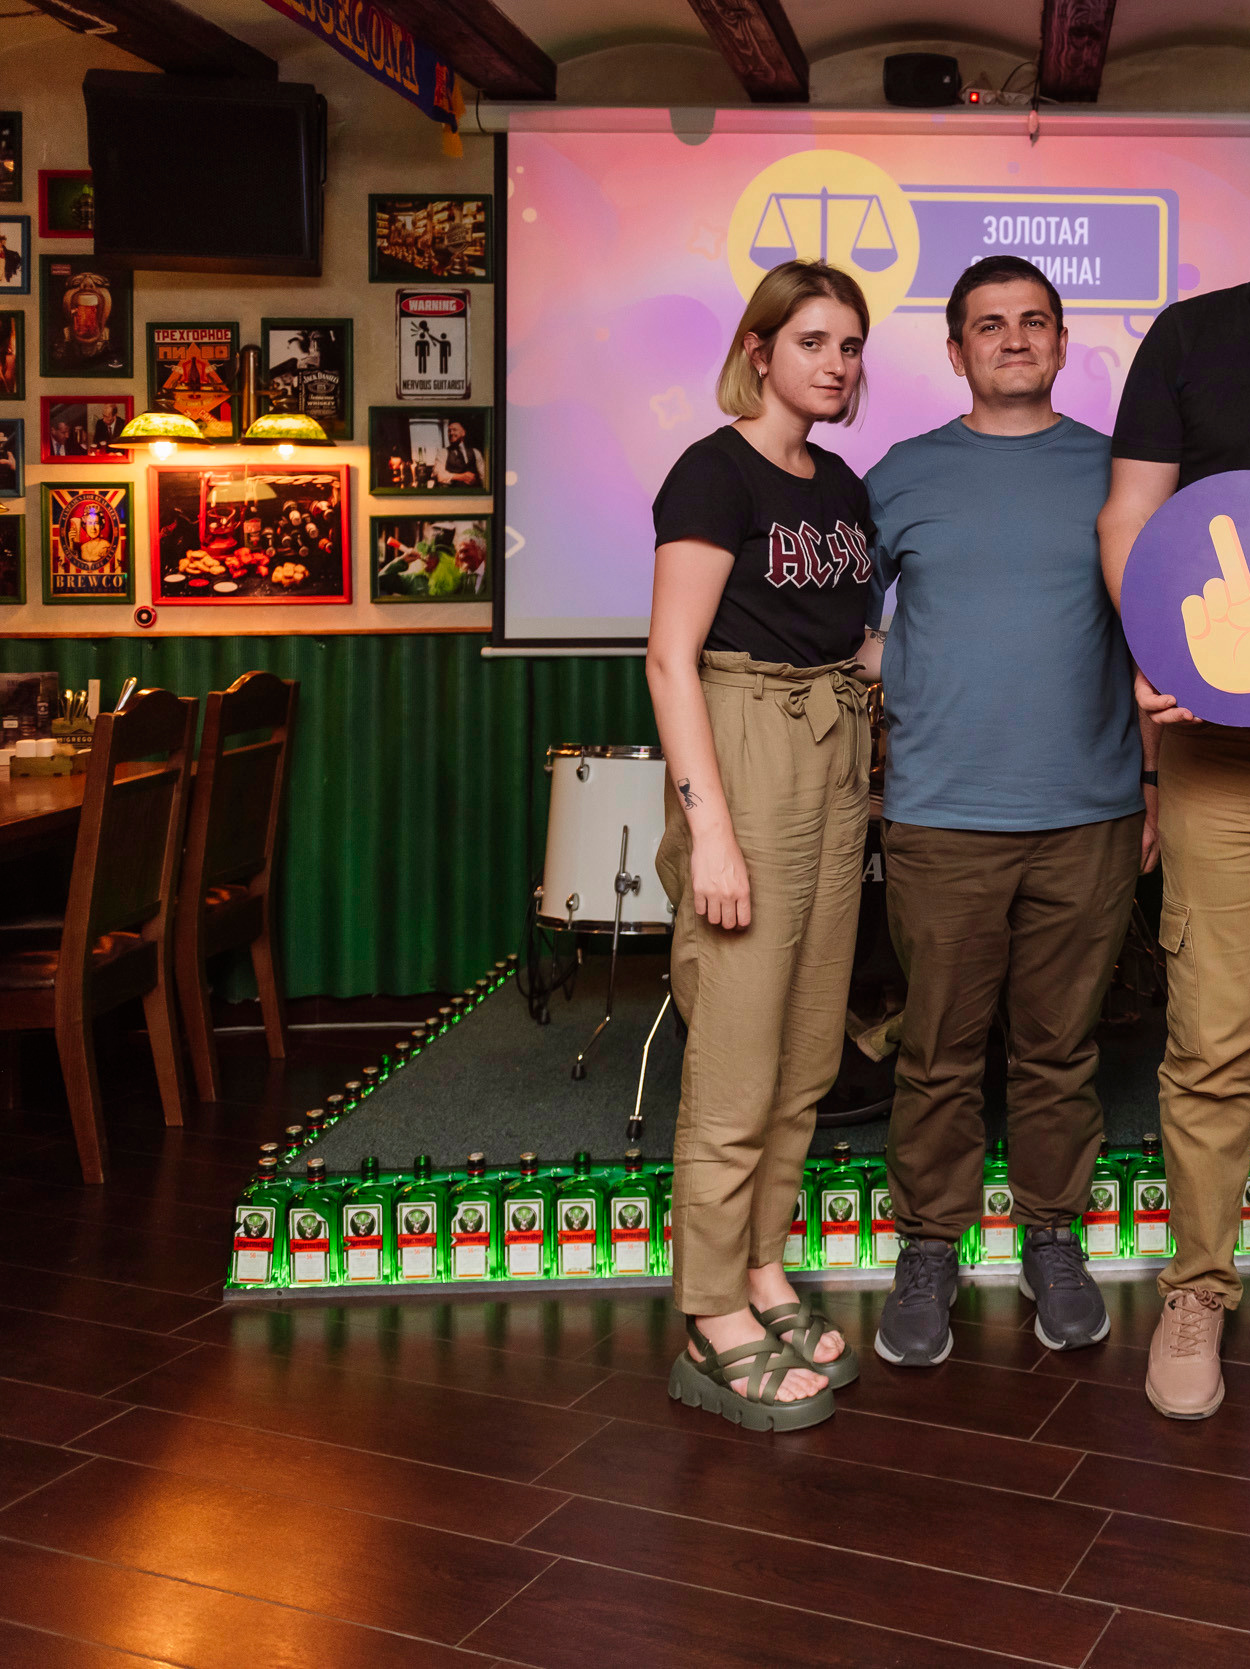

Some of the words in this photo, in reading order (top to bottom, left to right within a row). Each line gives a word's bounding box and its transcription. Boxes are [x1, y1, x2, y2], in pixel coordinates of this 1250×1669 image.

[983, 215, 1089, 245] ЗОЛОТАЯ
[408, 300, 457, 311] WARNING
[155, 329, 231, 341] ТРЕХГОРНОЕ
[402, 380, 432, 390] NERVOUS
[433, 380, 465, 390] GUITARIST
[56, 575, 124, 588] BREWCO
